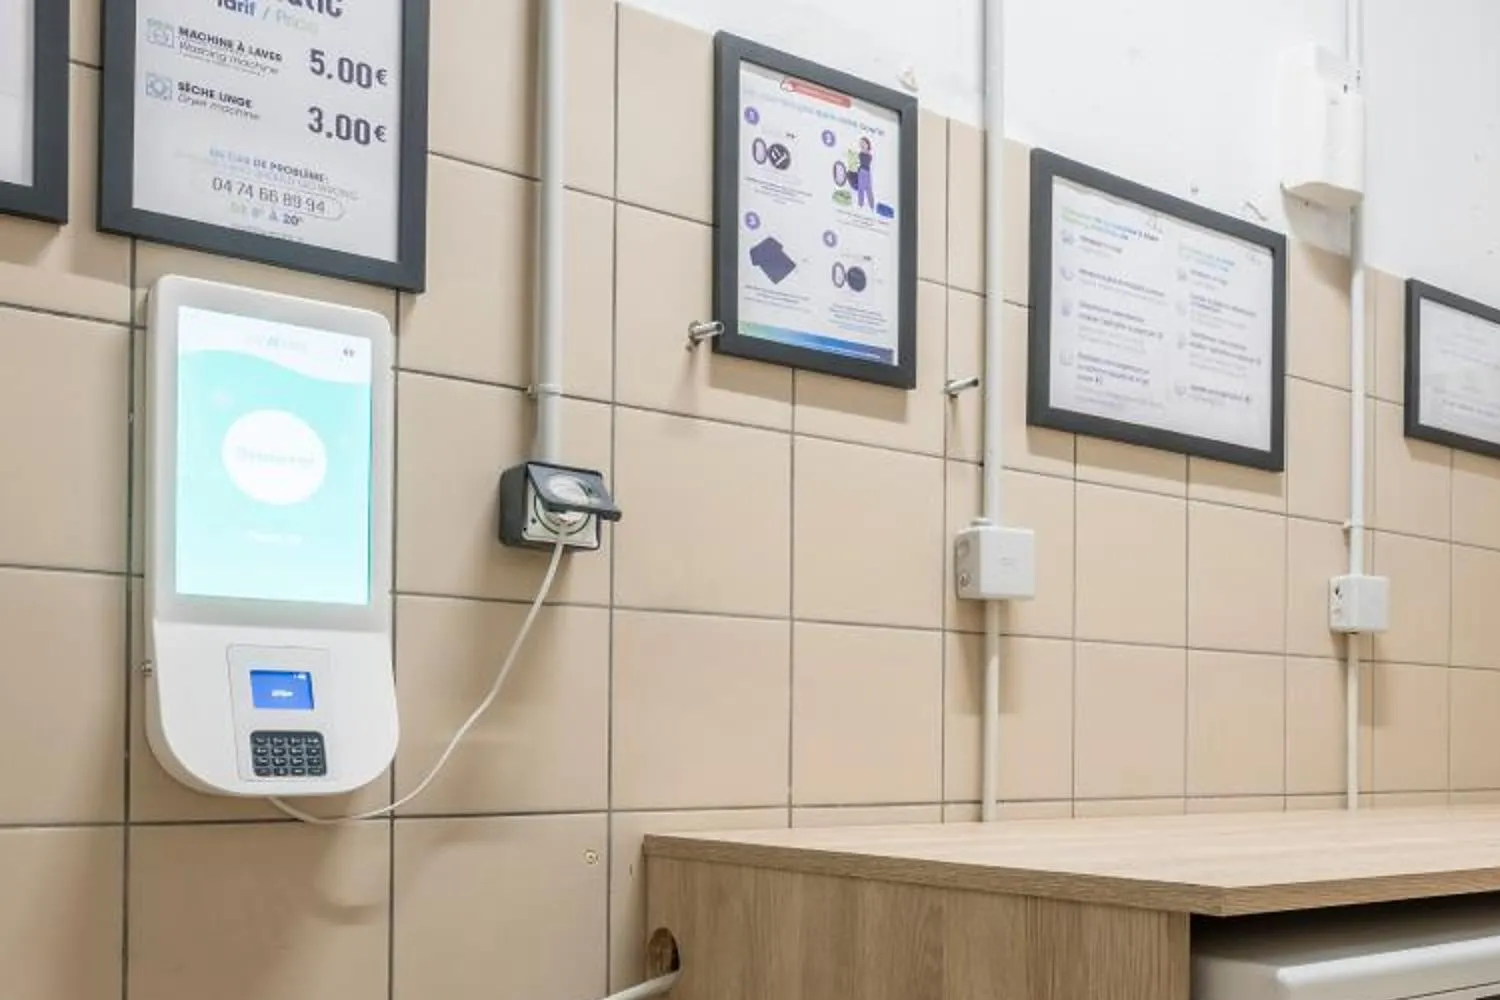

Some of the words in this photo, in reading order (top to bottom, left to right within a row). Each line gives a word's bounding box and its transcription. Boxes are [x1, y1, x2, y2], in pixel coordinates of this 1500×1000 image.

[178, 26, 233, 49] MACHINE
[309, 47, 388, 90] 5.00€
[219, 90, 253, 109] LINGE
[307, 106, 388, 146] 3.00€
[212, 176, 233, 193] 04
[237, 182, 255, 199] 74
[305, 197, 326, 213] 94
